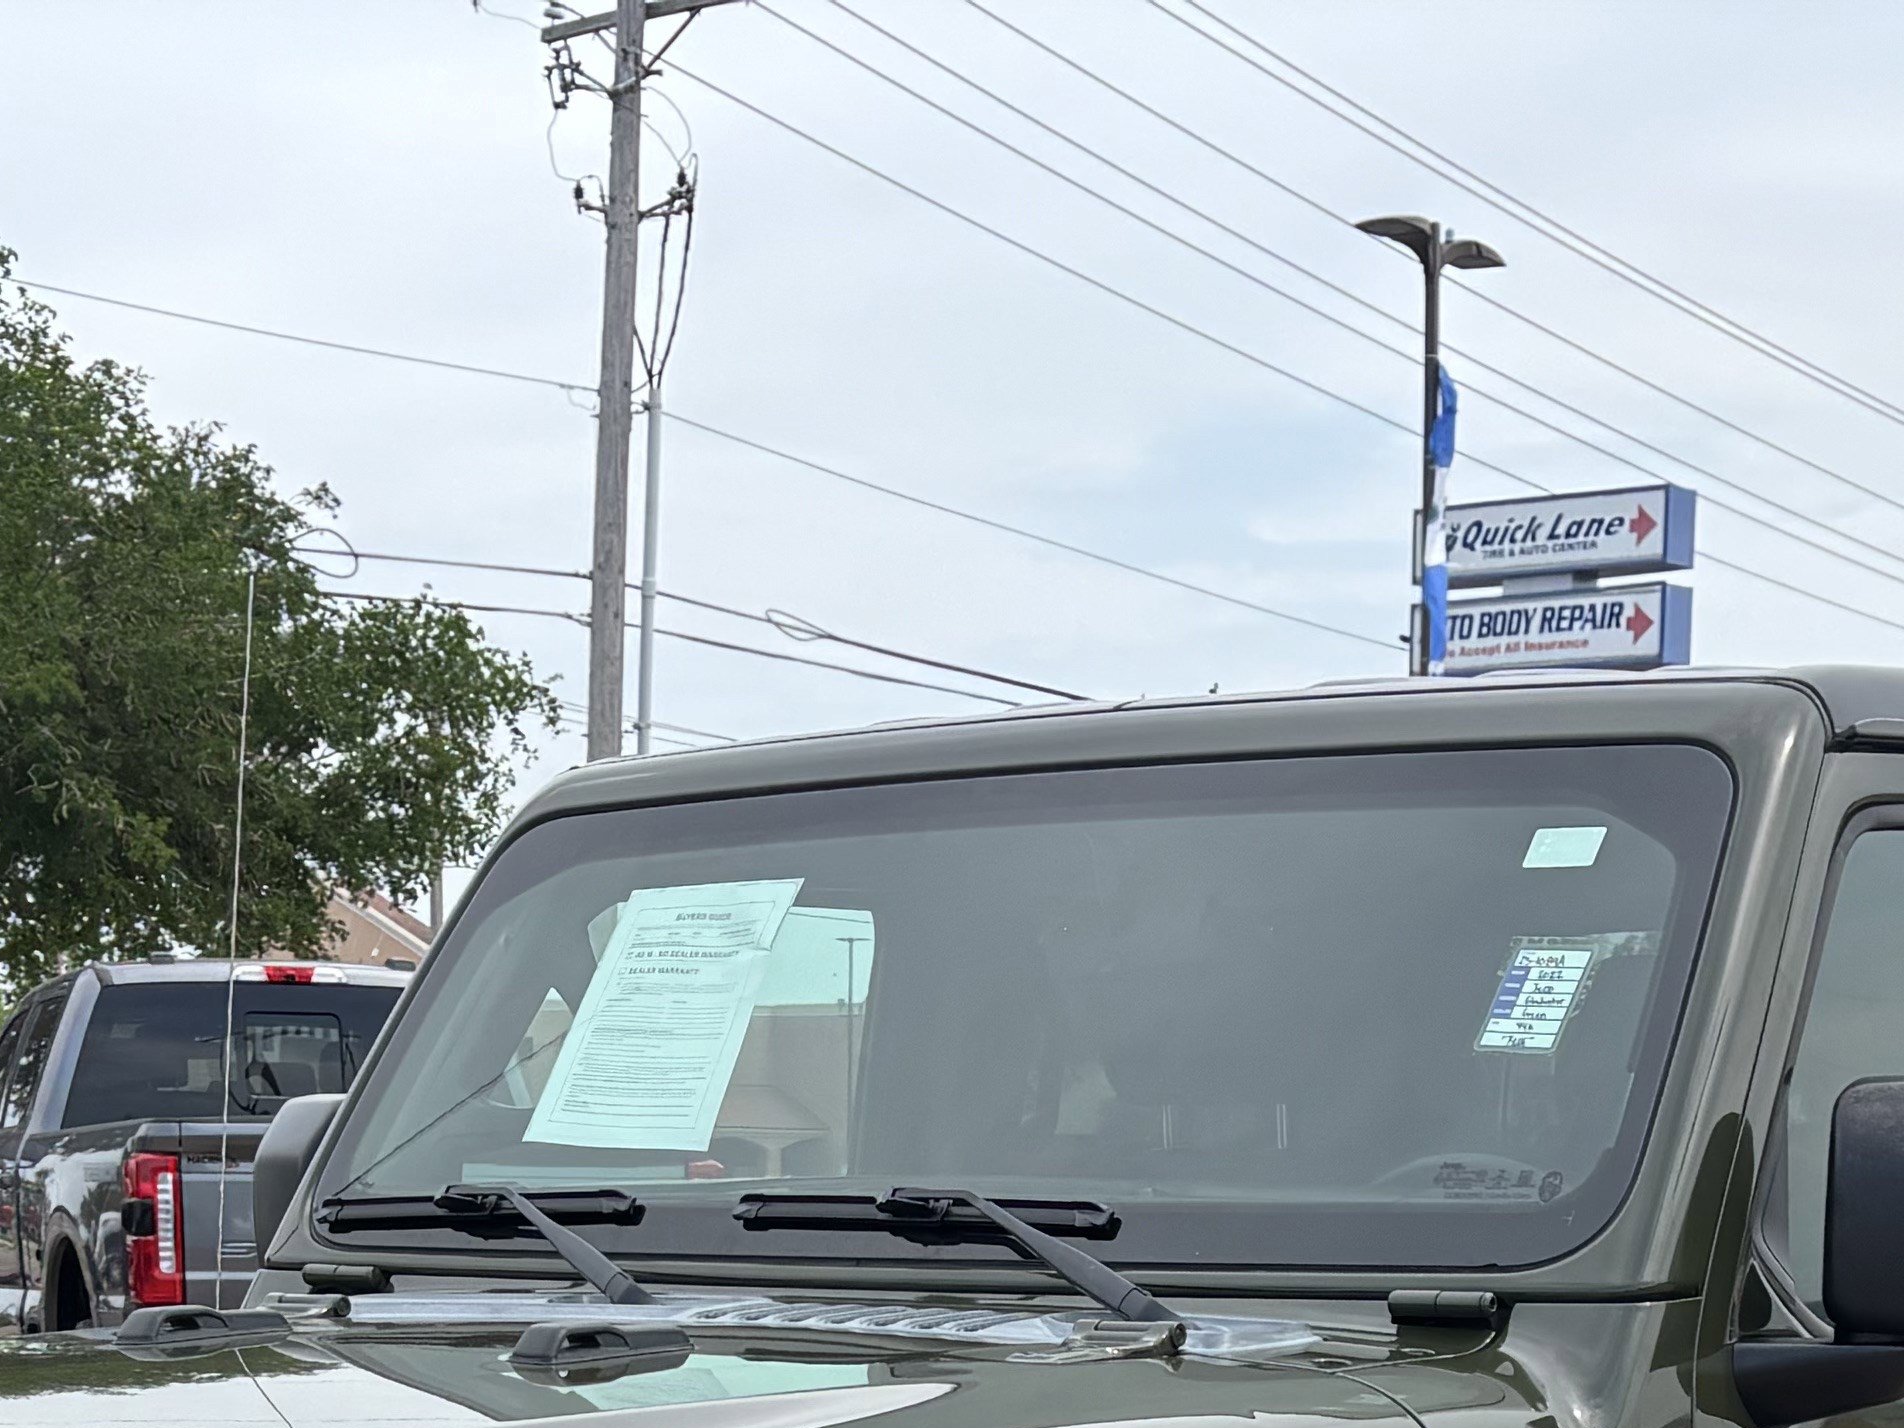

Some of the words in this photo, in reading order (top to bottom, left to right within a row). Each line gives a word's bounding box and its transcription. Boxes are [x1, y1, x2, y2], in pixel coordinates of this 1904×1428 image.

[1462, 514, 1544, 552] Quick
[1547, 512, 1626, 541] Lane
[1518, 545, 1549, 557] AUTO
[1552, 540, 1599, 554] CENTER
[1478, 606, 1538, 639] BODY
[1539, 601, 1625, 635] REPAIR
[1460, 645, 1502, 658] Accept
[1524, 638, 1590, 652] Insurance
